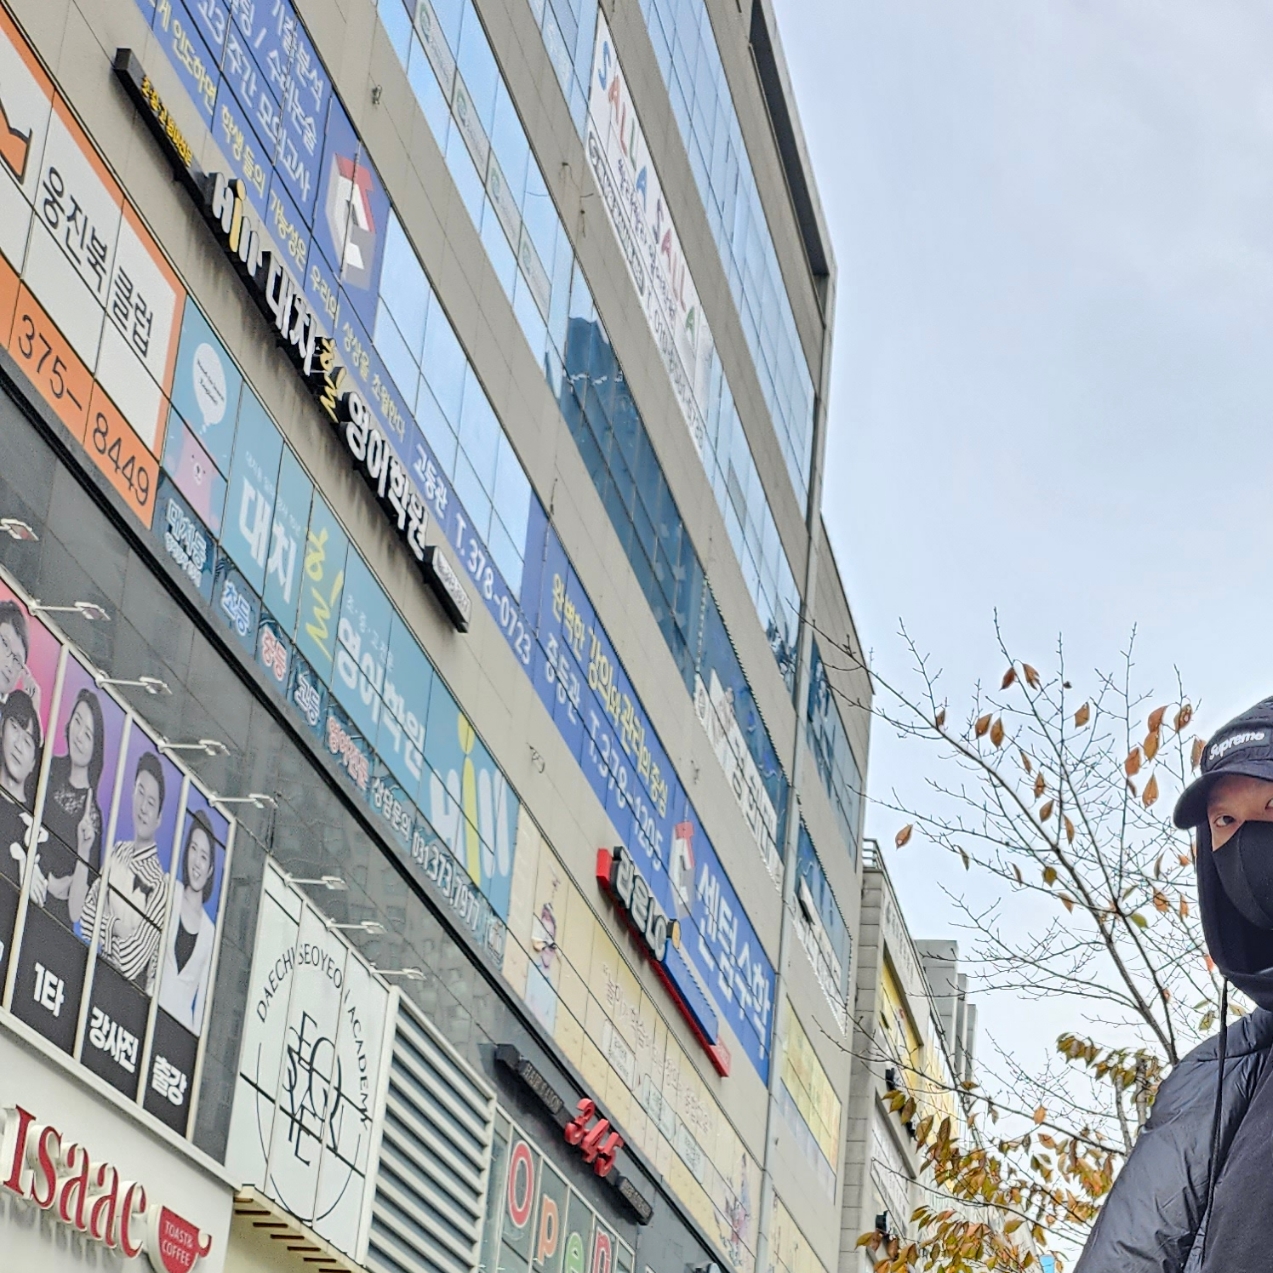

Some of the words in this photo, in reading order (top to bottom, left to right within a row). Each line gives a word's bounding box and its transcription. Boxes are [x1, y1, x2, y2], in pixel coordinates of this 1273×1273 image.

[17, 312, 151, 507] 375-8449
[1209, 730, 1266, 760] Supreme
[89, 1005, 140, 1075] 강사진
[152, 1053, 188, 1108] 출강
[2, 1103, 148, 1261] Isaac
[564, 1097, 625, 1178] 345
[162, 1239, 191, 1267] COFFEE
